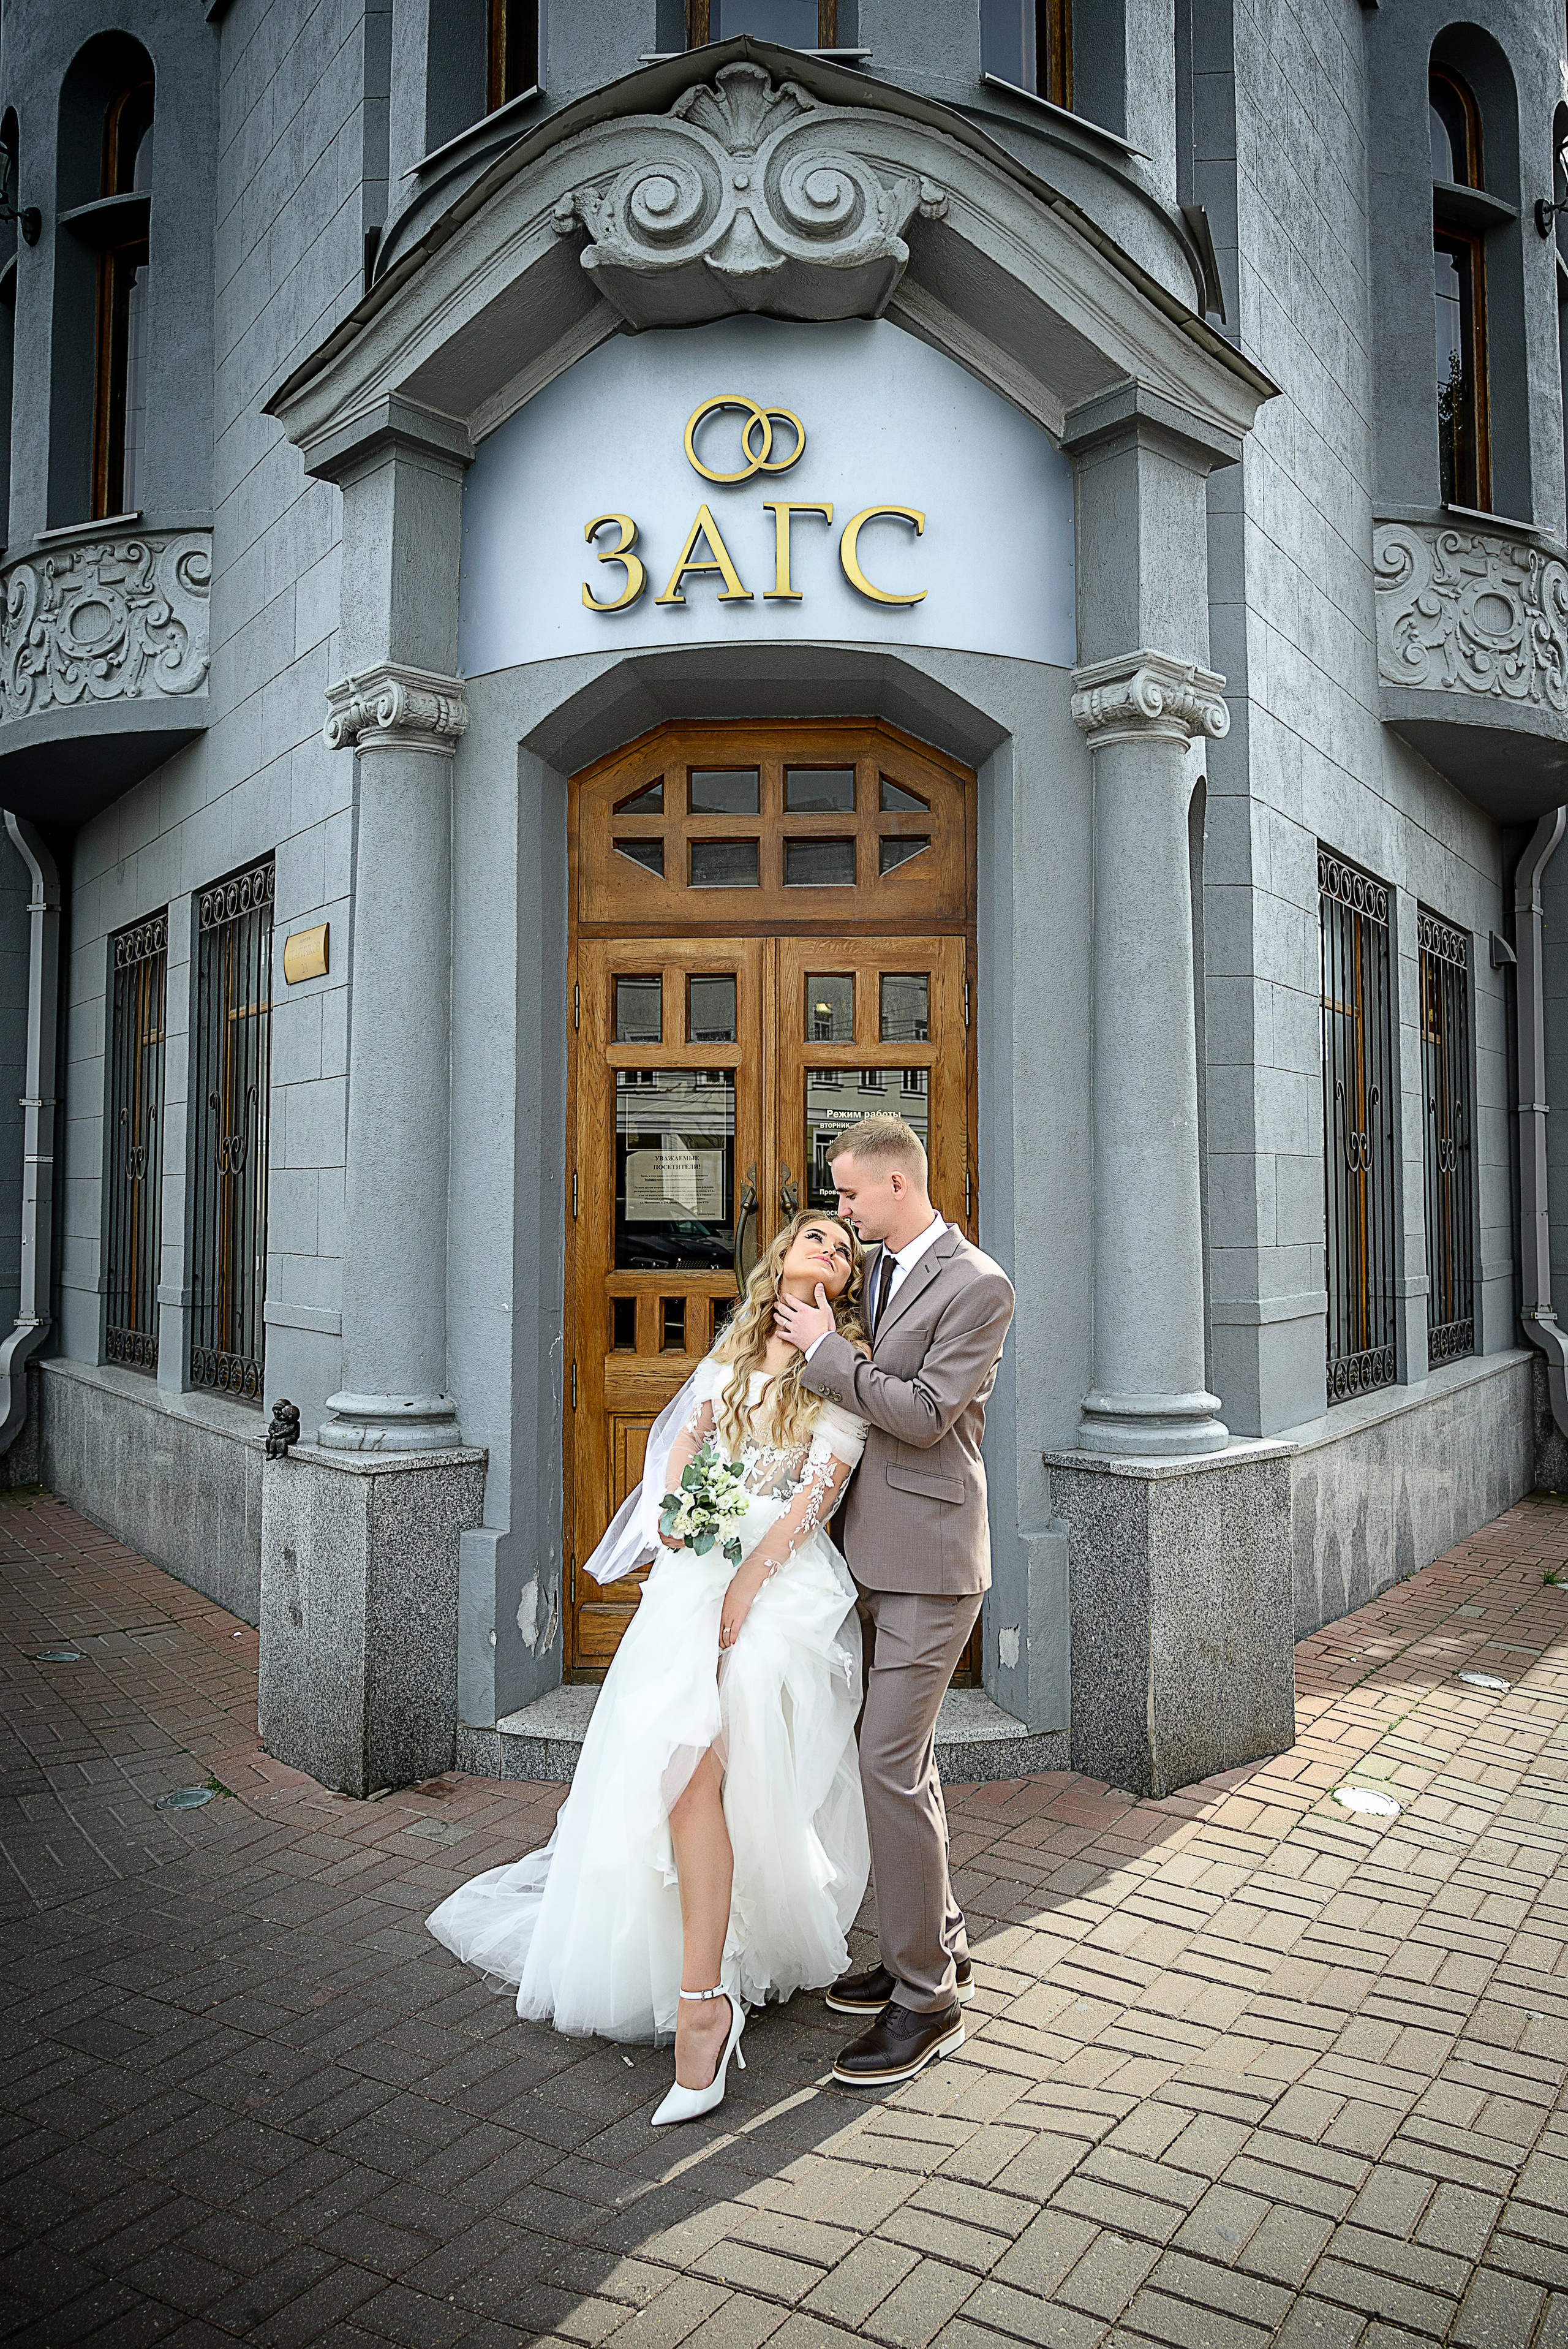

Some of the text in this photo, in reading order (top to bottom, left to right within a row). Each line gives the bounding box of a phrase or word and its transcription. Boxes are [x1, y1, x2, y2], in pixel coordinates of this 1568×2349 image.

[582, 502, 929, 613] ЗАГС
[826, 1110, 901, 1119] Режим работы
